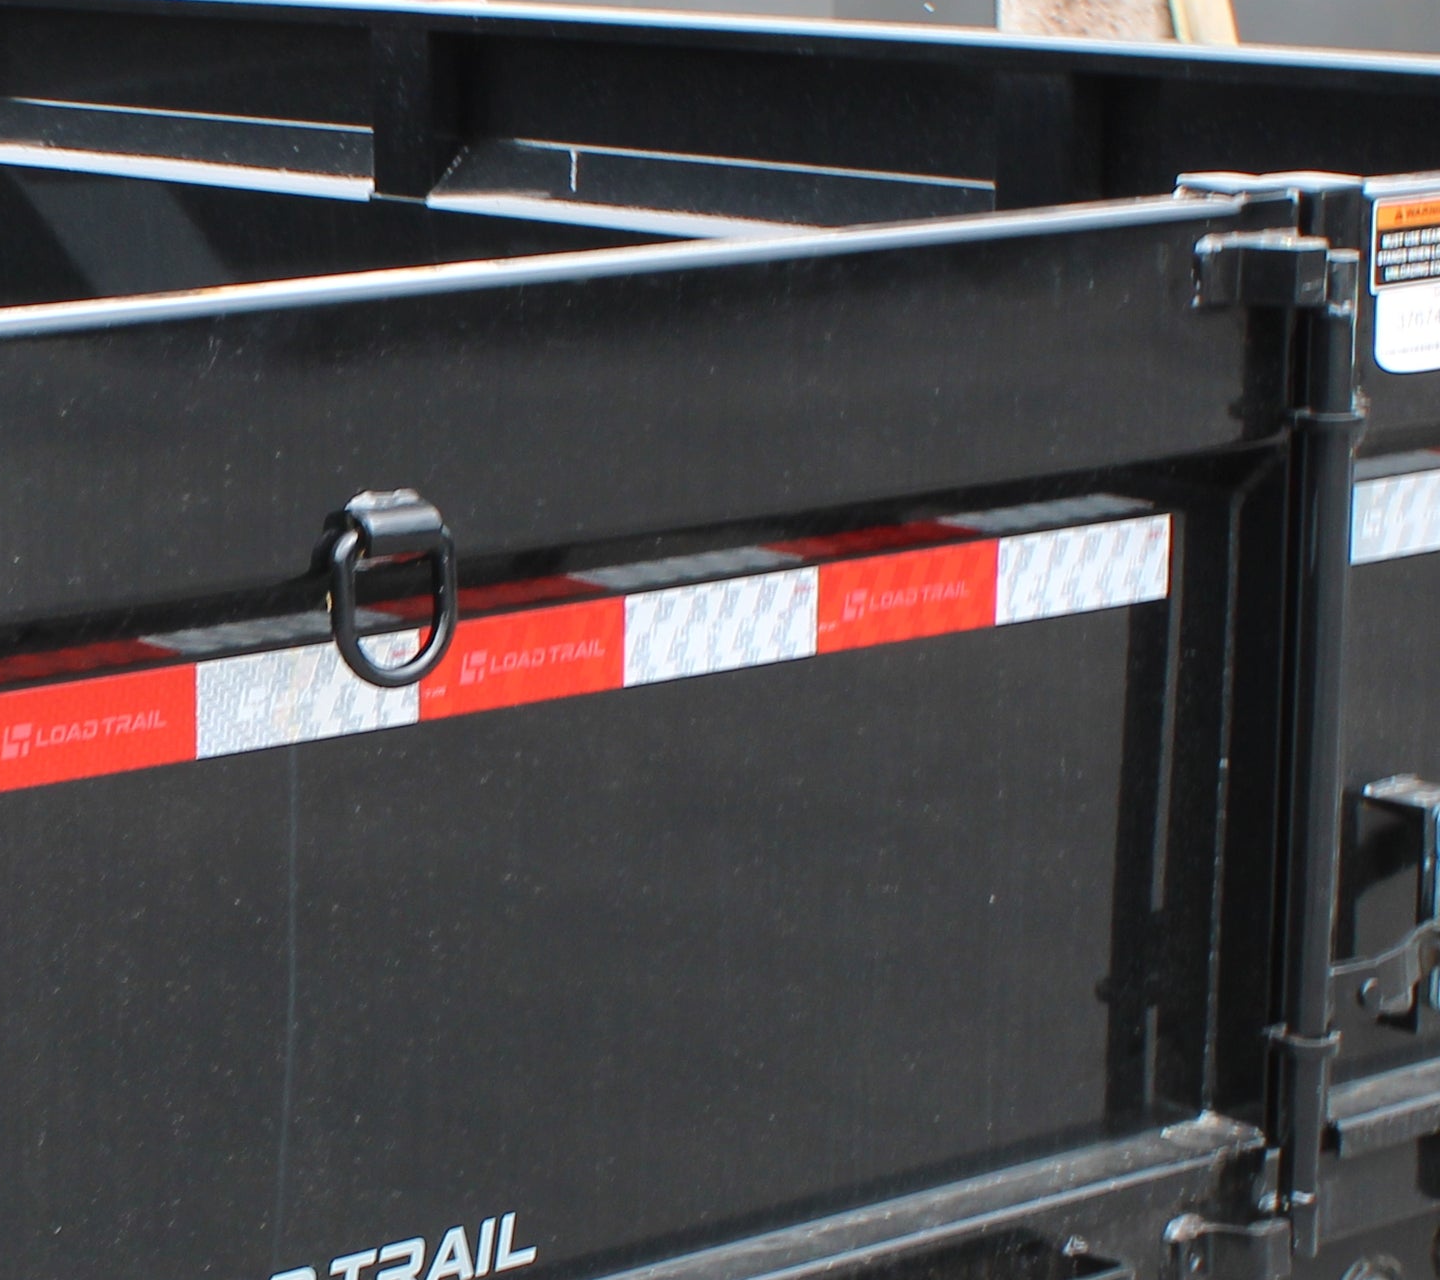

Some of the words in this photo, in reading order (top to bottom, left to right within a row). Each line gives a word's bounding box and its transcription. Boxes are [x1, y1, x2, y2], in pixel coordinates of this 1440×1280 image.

[869, 590, 918, 611] LOAD
[921, 581, 970, 602] TRAIL
[489, 646, 546, 674] LOAD
[549, 639, 607, 665] TRAIL
[35, 718, 99, 748] LOAD
[102, 708, 168, 737] TRAIL
